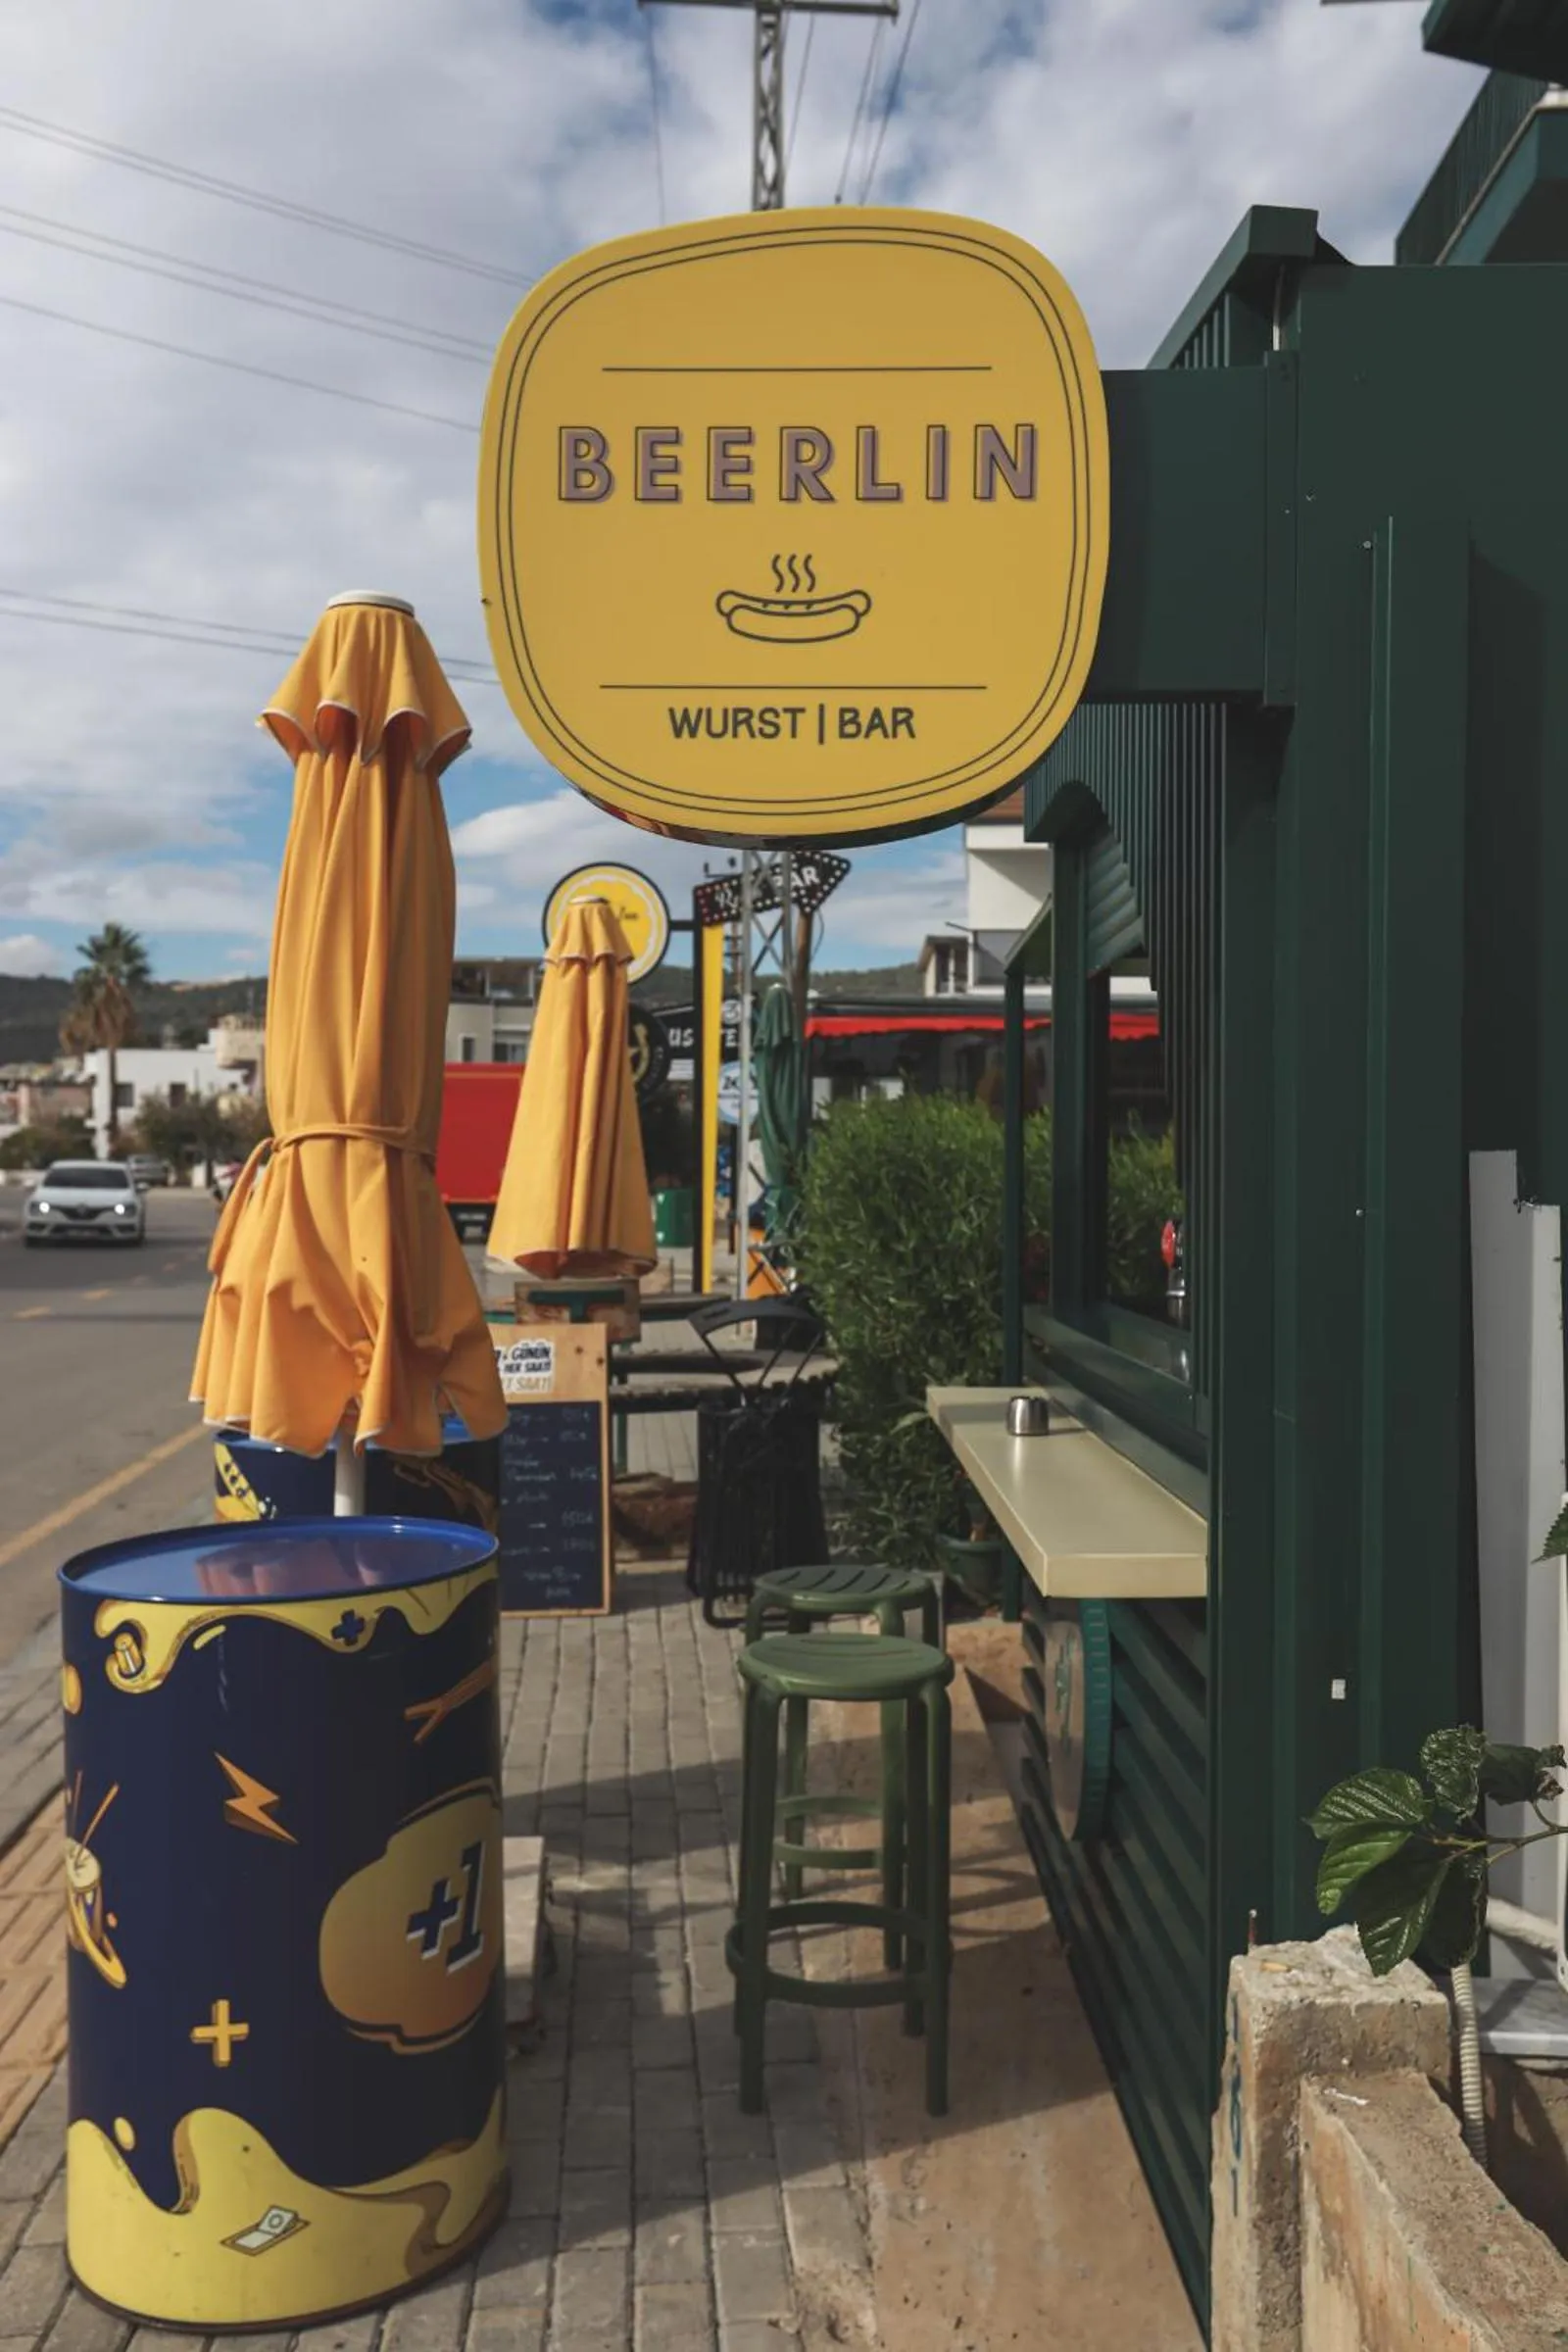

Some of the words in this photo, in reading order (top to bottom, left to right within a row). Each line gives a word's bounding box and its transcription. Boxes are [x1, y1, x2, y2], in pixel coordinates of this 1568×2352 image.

[558, 423, 1038, 504] BEERLIN
[667, 707, 806, 739] WURST
[838, 707, 916, 739] BAR
